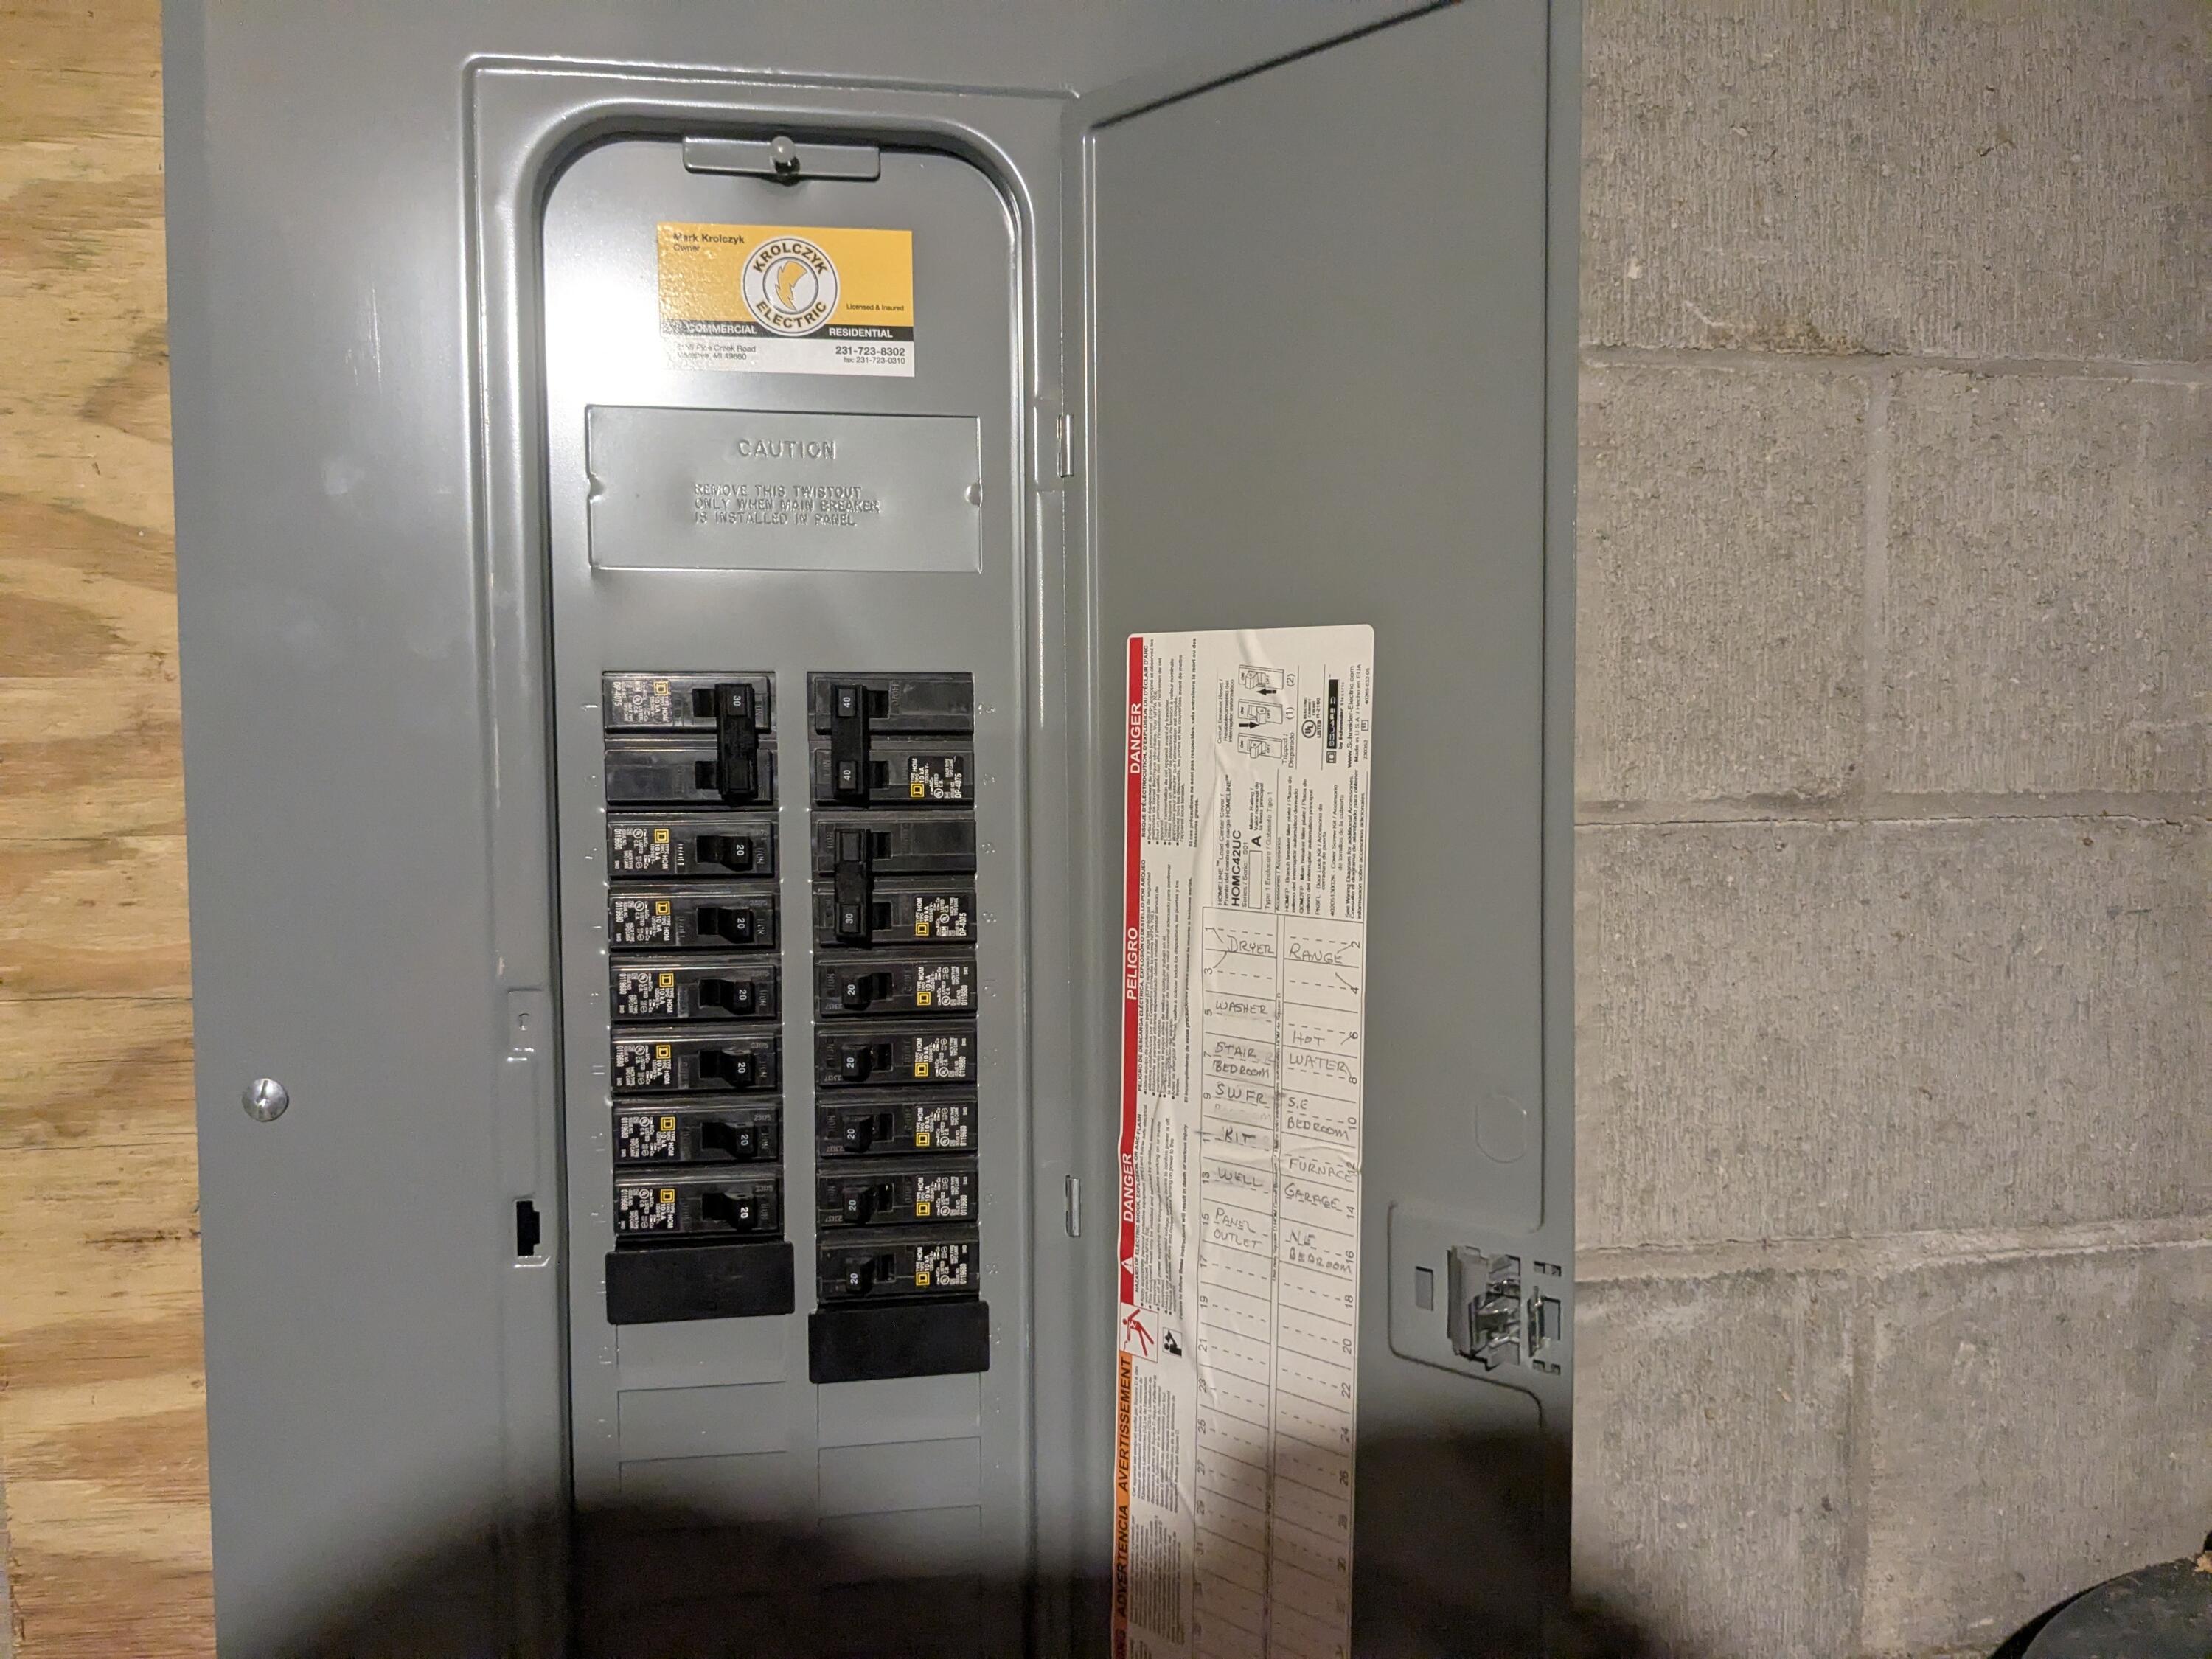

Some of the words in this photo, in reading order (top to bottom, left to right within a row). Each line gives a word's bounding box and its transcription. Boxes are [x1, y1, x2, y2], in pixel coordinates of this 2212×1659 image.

[673, 233, 699, 242] Mark
[701, 234, 745, 245] Krolczyk
[673, 243, 700, 252] Owner
[753, 243, 828, 274] KROLCZYK
[756, 300, 827, 328] ELECTRIC
[846, 303, 874, 311] Licensed
[882, 304, 904, 312] Insured
[686, 323, 757, 335] COMMERCIAL
[829, 327, 893, 338] RESIDENTIAL
[737, 345, 757, 353] Road
[835, 346, 905, 357] 231-723-8302
[856, 356, 905, 364] 231-723-0310
[737, 439, 837, 459] CAUTION
[694, 484, 747, 497] REMOVE
[754, 484, 786, 498] THIS
[793, 485, 862, 500] TWISTOUT
[694, 498, 731, 510] ONLY
[737, 499, 775, 511] WHEN
[780, 499, 815, 512] MAIN
[820, 500, 881, 514] BREAKER
[695, 512, 708, 524] IS
[715, 512, 788, 524] INSTALLED
[795, 513, 808, 526] IN
[814, 513, 858, 526] PANEL
[1286, 673, 1295, 687] (2)
[733, 695, 742, 707] 30
[843, 696, 851, 708] 40
[1144, 698, 1148, 706] OU
[1285, 706, 1295, 720] (1)
[1346, 666, 1354, 768] www.Schneider-Electric.com
[1130, 703, 1141, 774] DANGER
[843, 769, 851, 781] 40
[1224, 840, 1230, 849] de
[1251, 835, 1262, 847] A
[736, 844, 745, 856] 20
[1231, 830, 1241, 907] HOMC42UC
[737, 917, 745, 930] 20
[845, 913, 854, 925] 30
[1227, 934, 1274, 953] DRYER
[1351, 940, 1360, 949] 2
[1289, 943, 1342, 964] RANGE
[1127, 927, 1138, 1001] PELIGRO
[1204, 967, 1213, 975] 3
[739, 989, 747, 1001] 20
[847, 984, 855, 995] 20
[1350, 986, 1359, 994] 4
[1215, 1000, 1267, 1015] WASHER
[1292, 1029, 1325, 1046] HOT
[1349, 1031, 1358, 1040] 6
[1214, 1041, 1256, 1058] STAIR
[846, 1057, 855, 1068] 20
[1138, 1054, 1143, 1062] DE
[1289, 1053, 1347, 1074] WATER
[737, 1062, 746, 1074] 20
[1213, 1060, 1269, 1078] BEDROOM
[1349, 1076, 1357, 1085] 8
[1287, 1116, 1349, 1141] BEDROOM
[1348, 1116, 1357, 1130] 10
[740, 1134, 749, 1146] 20
[847, 1128, 855, 1140] 20
[1225, 1126, 1256, 1143] KIT
[1134, 1150, 1138, 1161] OR
[1347, 1162, 1357, 1174] 12
[1202, 1171, 1210, 1184] 13
[1217, 1167, 1263, 1187] WELL
[1122, 1152, 1134, 1222] DANGER
[1284, 1182, 1340, 1209] GARAGE
[849, 1200, 857, 1211] 20
[740, 1207, 749, 1219] 20
[1201, 1212, 1209, 1225] 15
[1347, 1206, 1356, 1220] 14
[1215, 1208, 1256, 1234] PANEL
[1214, 1229, 1262, 1249] OUTLET
[1135, 1256, 1139, 1265] OF
[1200, 1254, 1208, 1268] 17
[1290, 1248, 1352, 1273] BEDROOM
[1346, 1250, 1354, 1264] 16
[850, 1273, 858, 1285] 20
[1200, 1295, 1208, 1308] 19
[1345, 1295, 1354, 1308] 18
[1198, 1338, 1208, 1352] 21
[1343, 1338, 1352, 1354] 20
[1199, 1377, 1207, 1393] 23
[1342, 1382, 1352, 1399] 22
[1118, 1357, 1131, 1492] AVERTISSEMENT
[1197, 1419, 1206, 1435] 25
[1341, 1427, 1350, 1443] 24
[1197, 1460, 1206, 1475] 27
[1116, 1505, 1129, 1618] ADVERTENCIA
